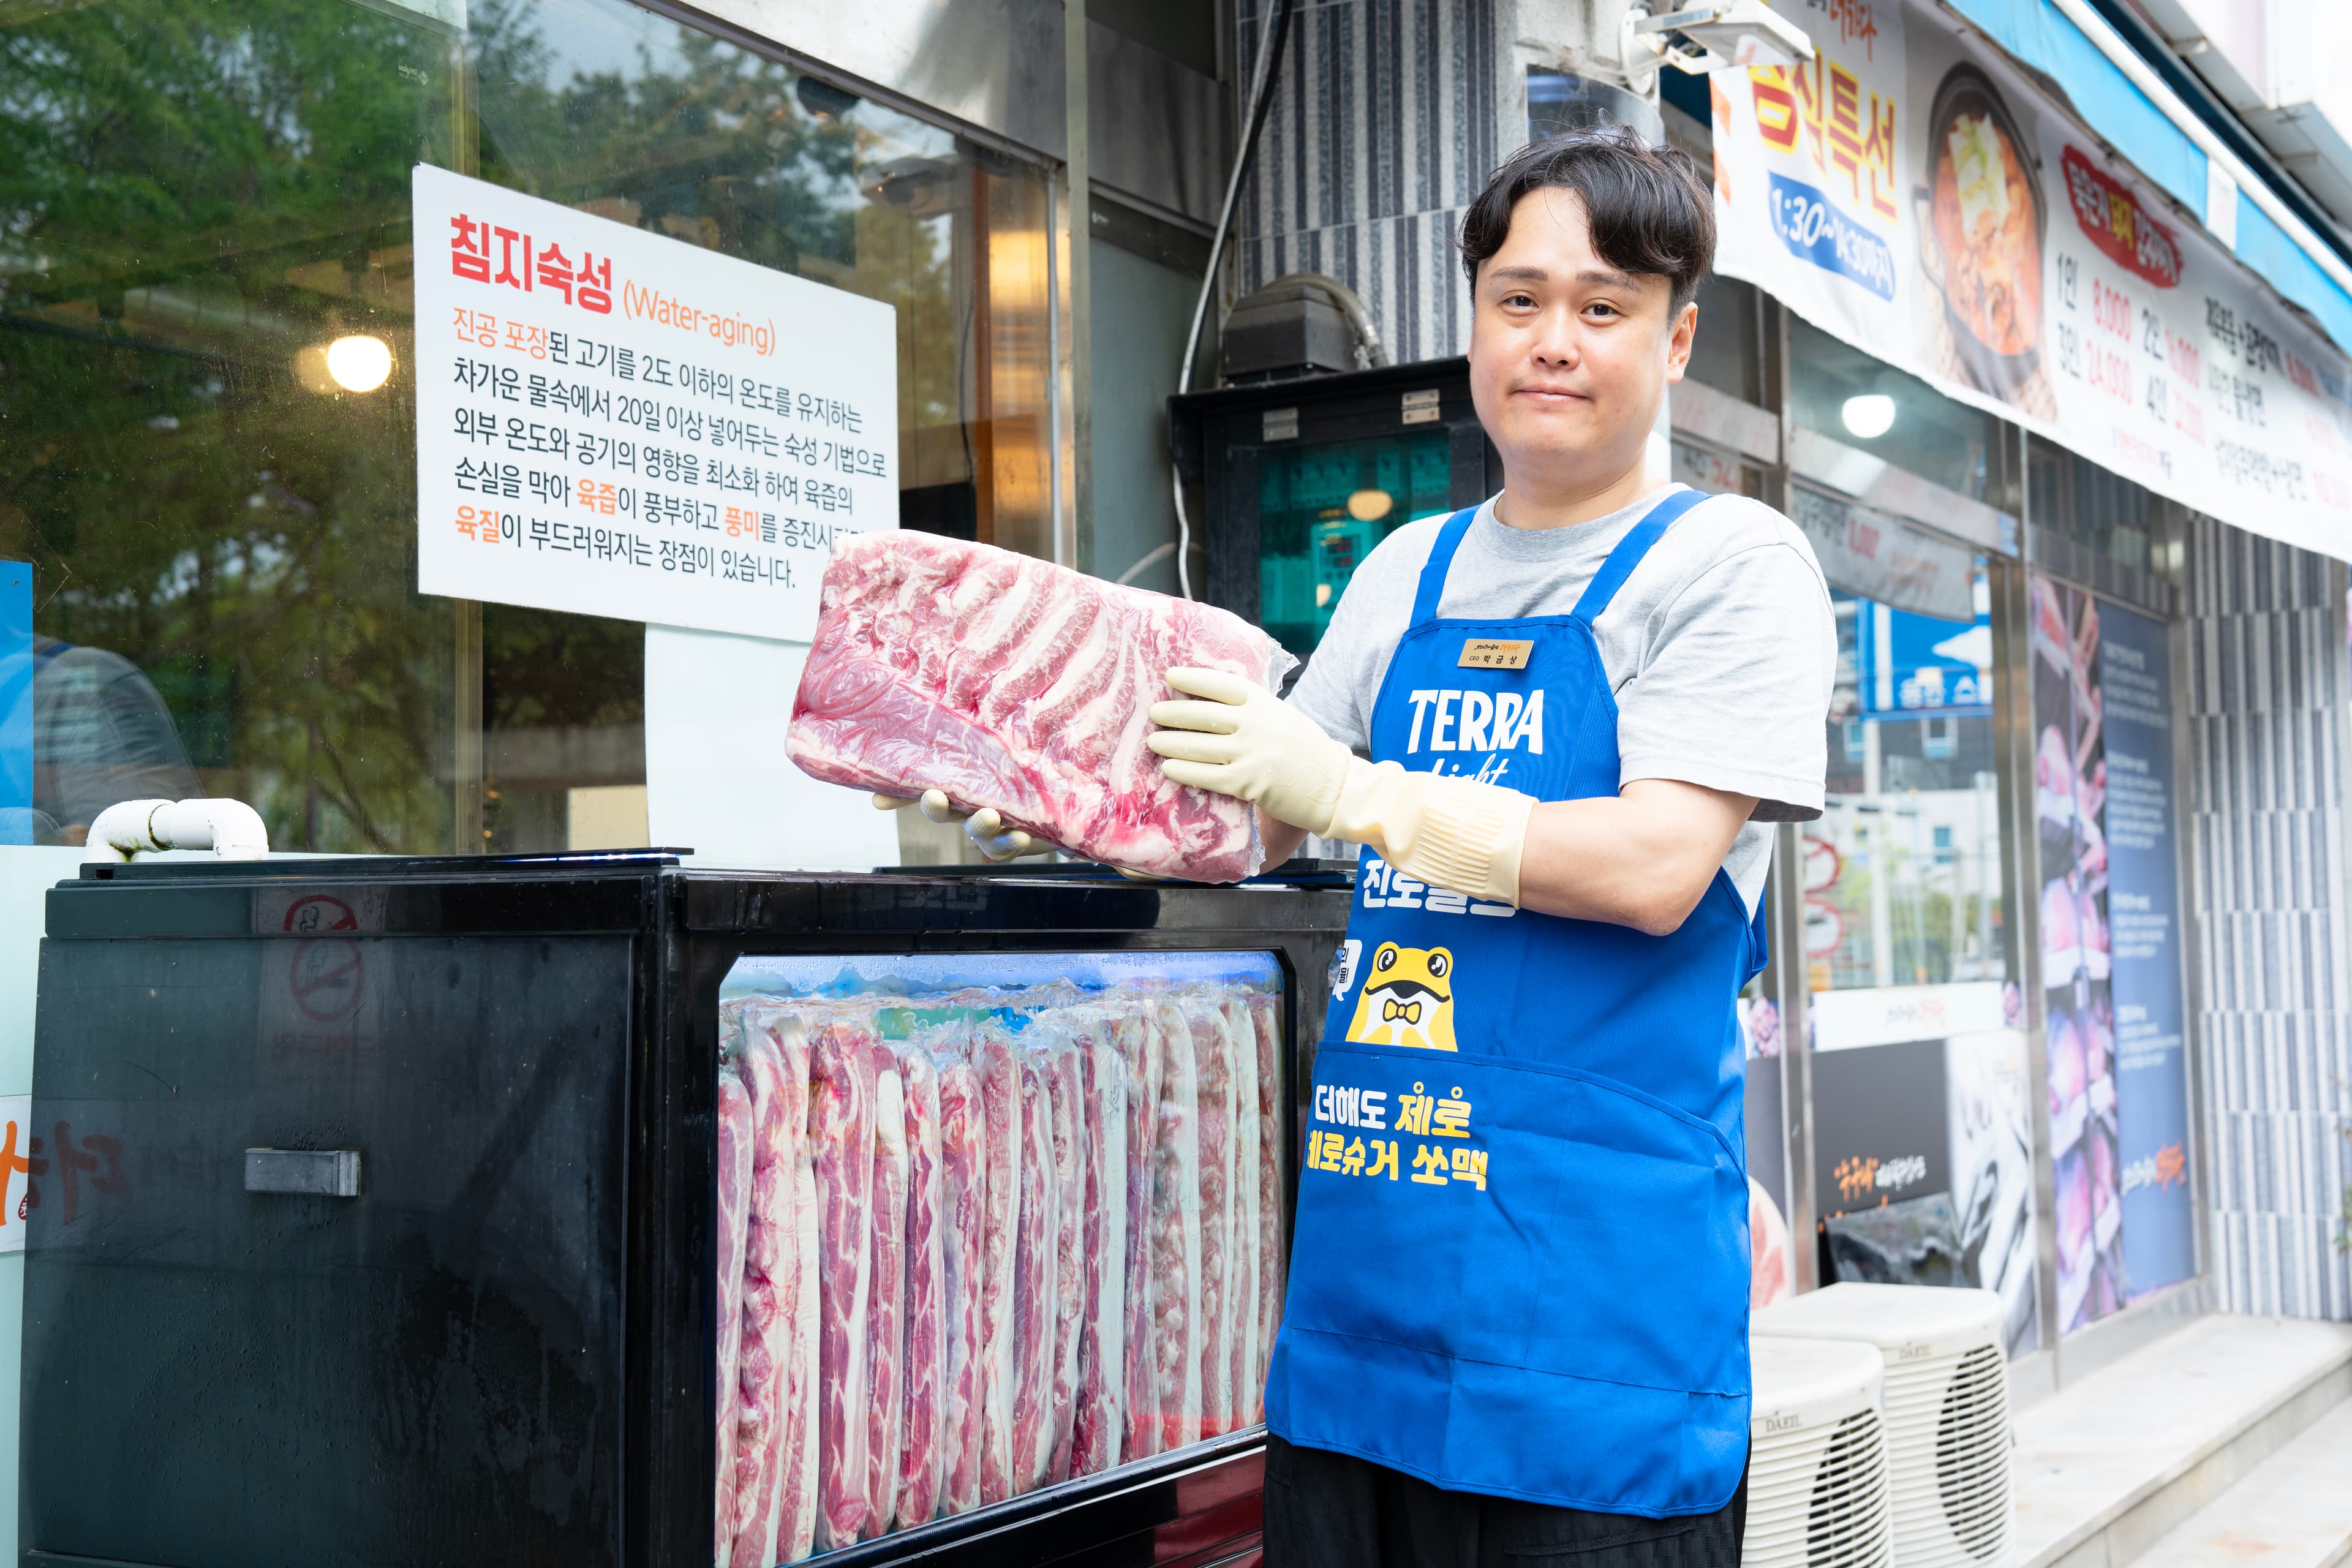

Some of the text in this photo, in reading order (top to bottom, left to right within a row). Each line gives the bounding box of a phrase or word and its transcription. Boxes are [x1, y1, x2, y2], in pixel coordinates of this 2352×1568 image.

[451, 213, 775, 357] 침지숙성 (Water-aging)
[453, 307, 862, 434] 진공 포장된 고기를 2도 이하의 온도를 유지하는
[454, 357, 886, 478] 차가운 물속에서 20일 이상 넣어두는 숙성 기법으로
[454, 407, 853, 516] 외부 온도와 공기의 영향을 최소화 하여 육즙의
[454, 457, 864, 553] 손실을 막아 육즙이 풍부하고 풍미를 증진시
[455, 505, 795, 588] 육질이 부드러워지는 장점이 있습니다.
[1407, 689, 1544, 755] TERRA
[1431, 753, 1509, 785] Liht
[1315, 1081, 1472, 1139] 더해도 제로
[1411, 1144, 1488, 1191] 쏘맥
[1766, 1415, 1803, 1431] DAEIL
